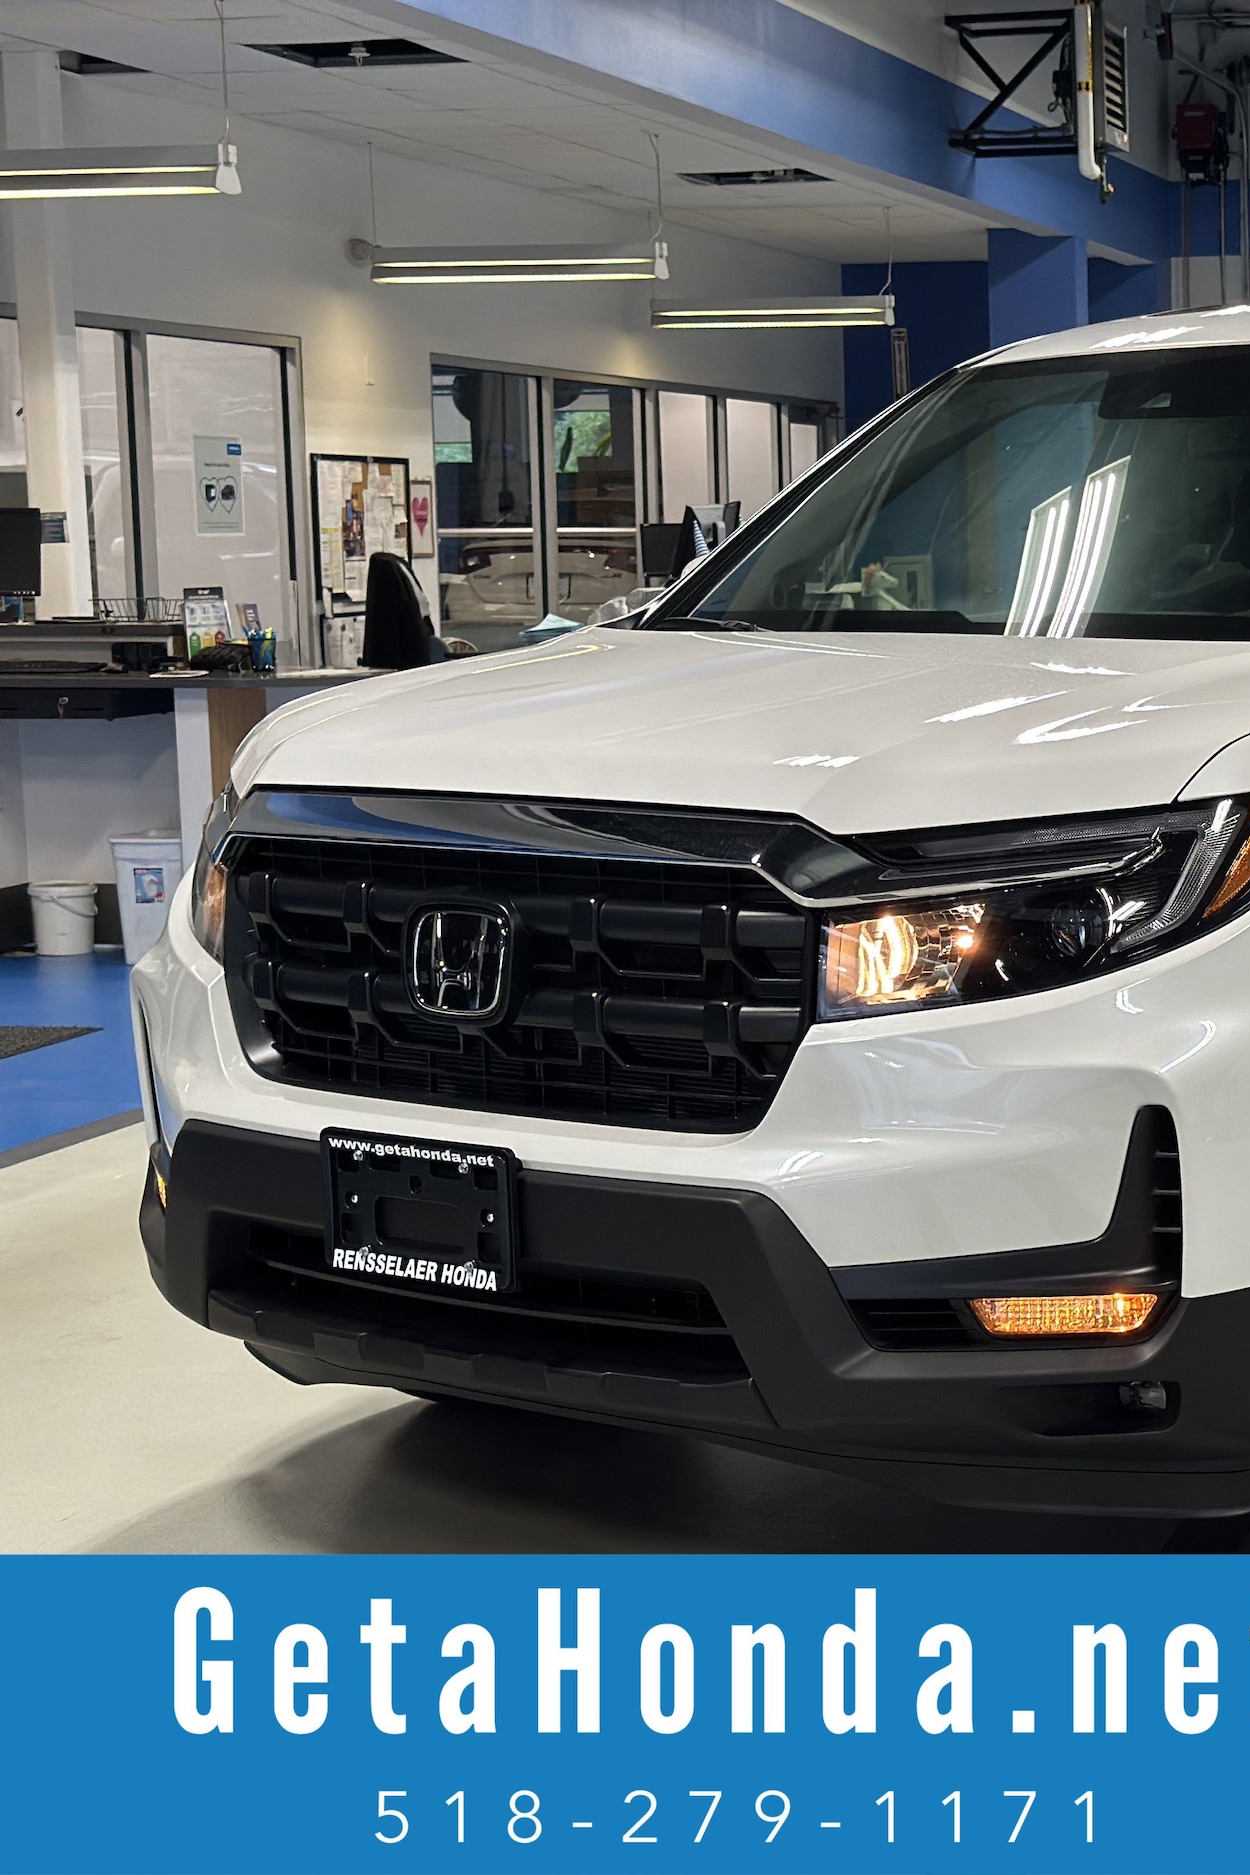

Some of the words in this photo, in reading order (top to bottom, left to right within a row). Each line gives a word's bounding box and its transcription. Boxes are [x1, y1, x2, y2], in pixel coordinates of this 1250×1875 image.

[328, 1137, 495, 1168] www.getahonda.net
[332, 1248, 438, 1282] RENSSELAER
[440, 1263, 498, 1292] HONDA
